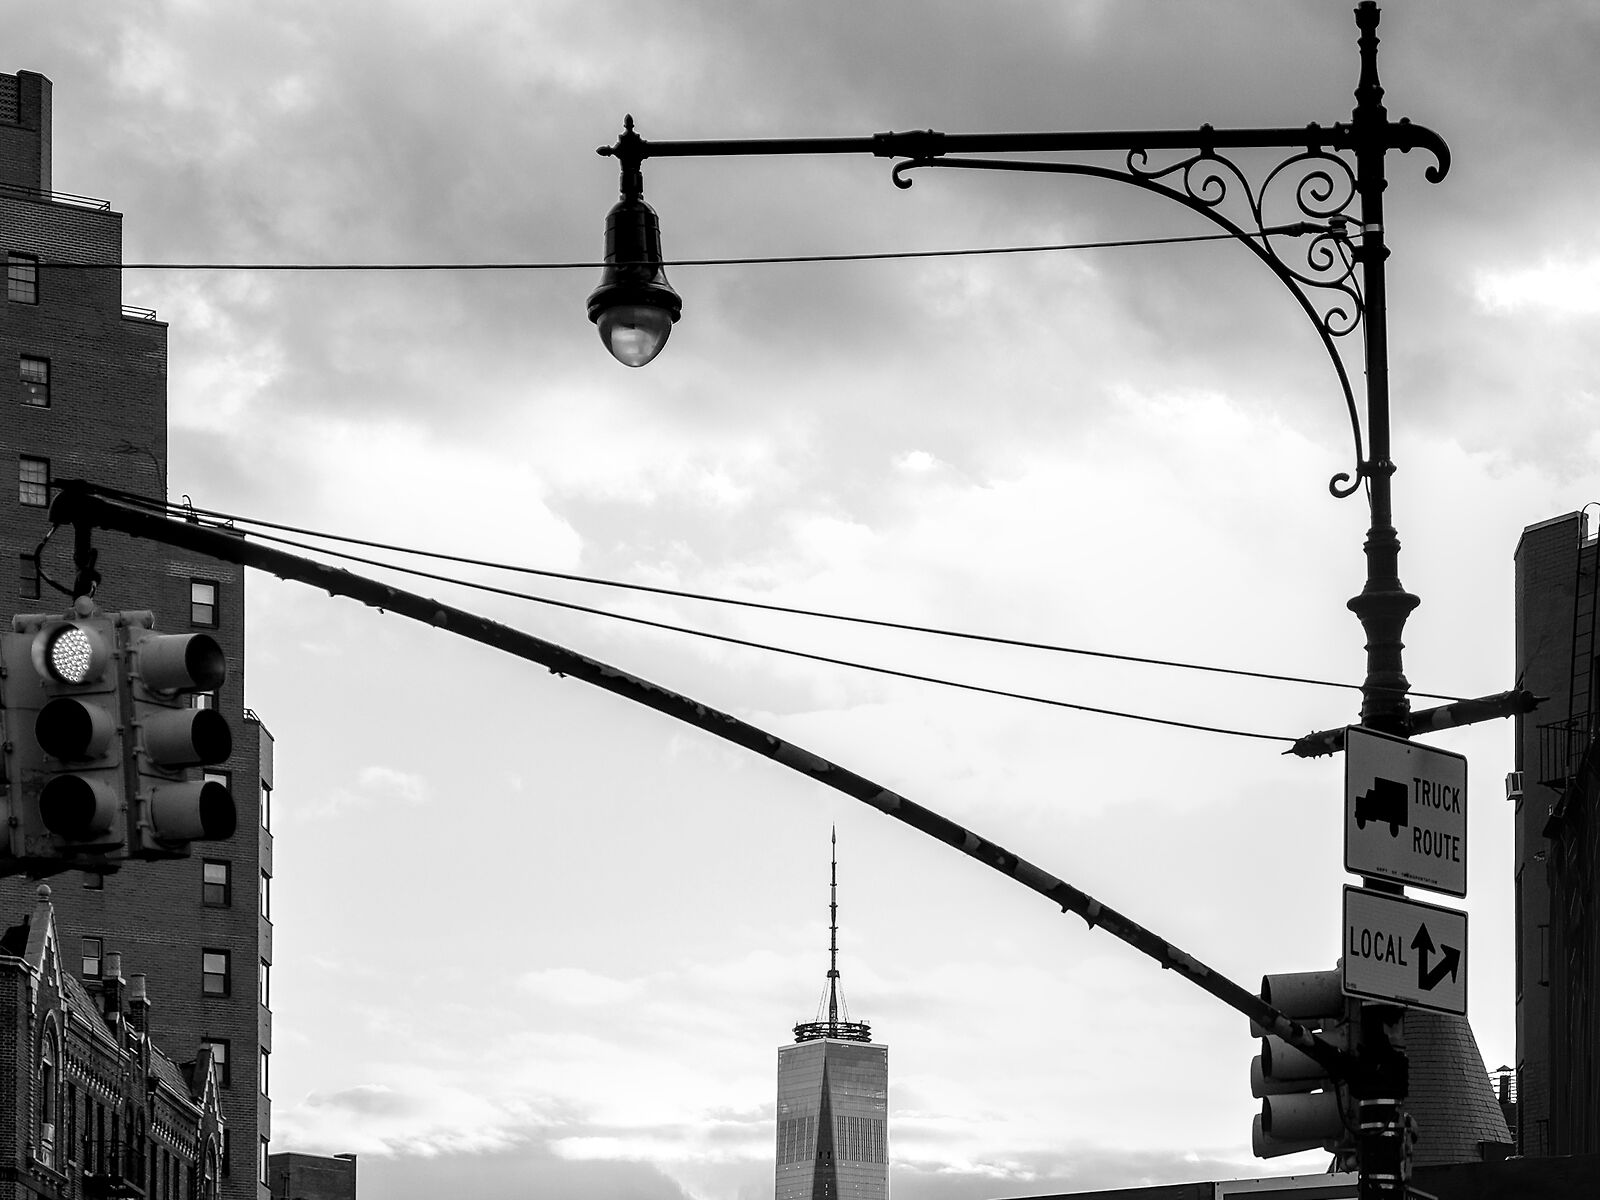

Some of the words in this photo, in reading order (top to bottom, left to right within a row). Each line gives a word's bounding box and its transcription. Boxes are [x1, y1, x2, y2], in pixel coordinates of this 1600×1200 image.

[1413, 777, 1460, 814] TRUCK
[1413, 826, 1460, 862] ROUTE
[1350, 926, 1407, 966] LOCAL
